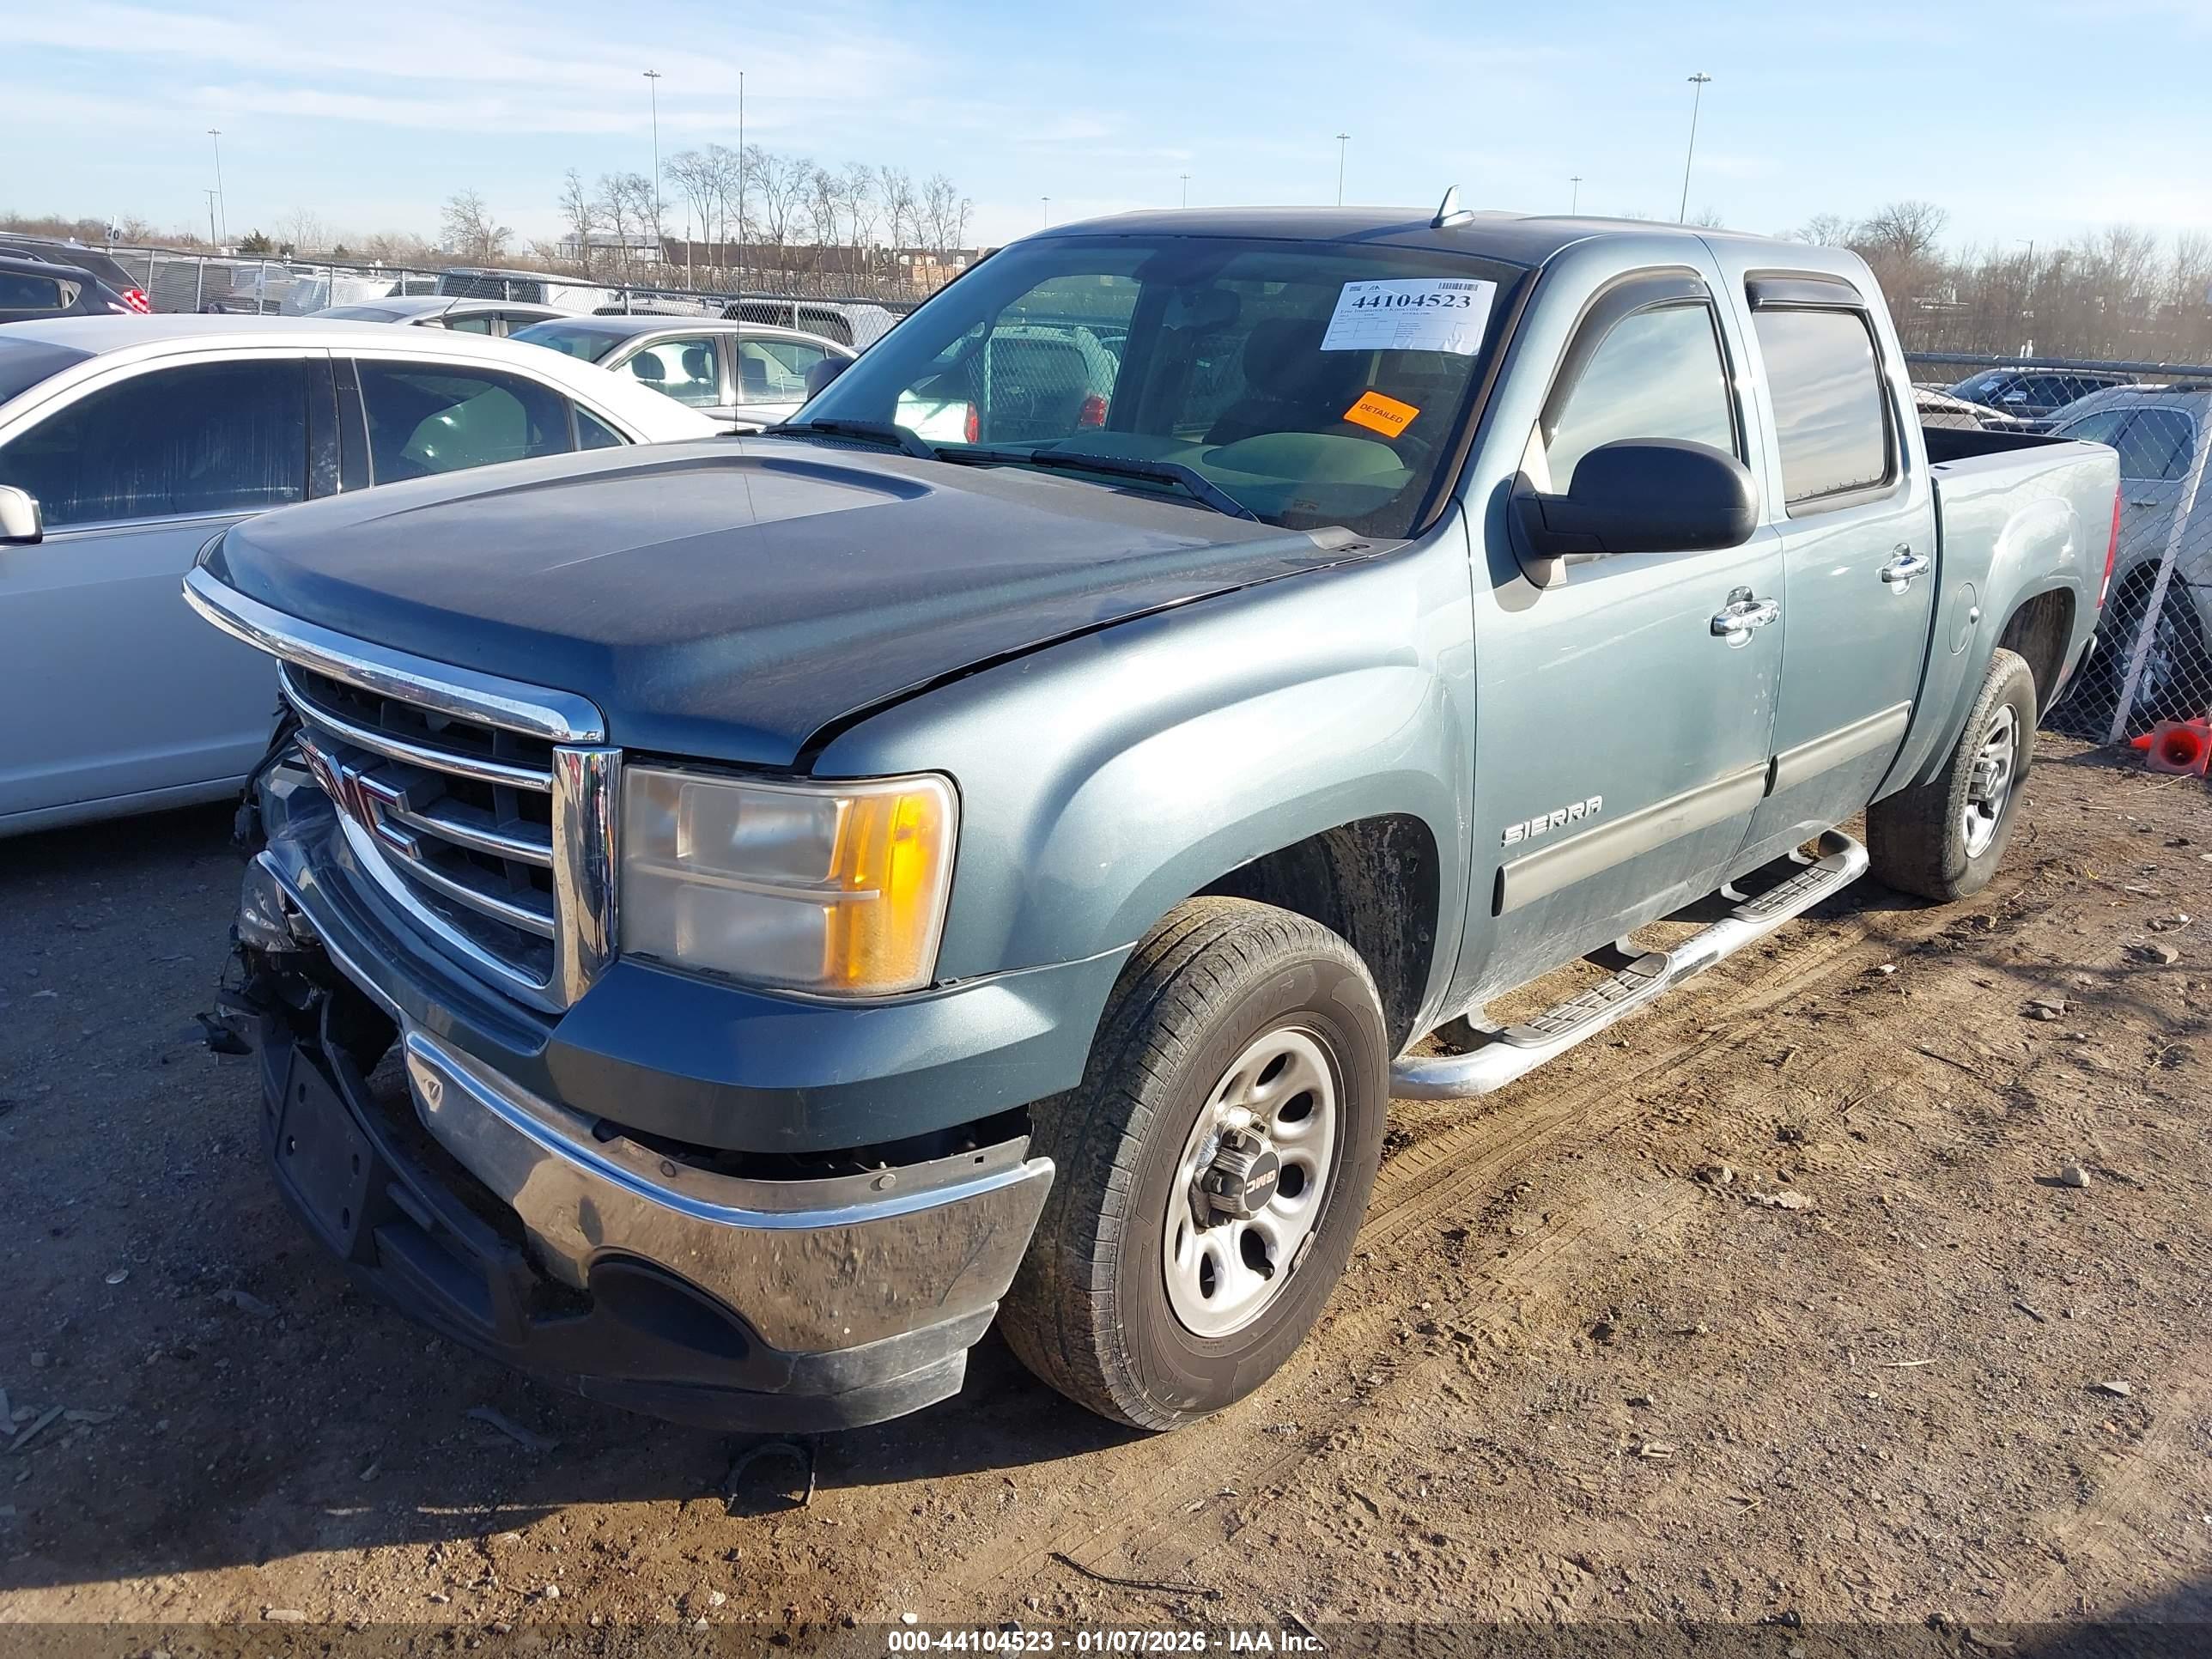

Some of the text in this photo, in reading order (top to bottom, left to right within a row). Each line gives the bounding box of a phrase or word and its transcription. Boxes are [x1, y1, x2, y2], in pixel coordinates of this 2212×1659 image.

[1352, 294, 1471, 309] 44104523
[1359, 403, 1403, 424] DETAILED
[1501, 795, 1603, 848] SIERRA
[1245, 1170, 1278, 1194] GMC
